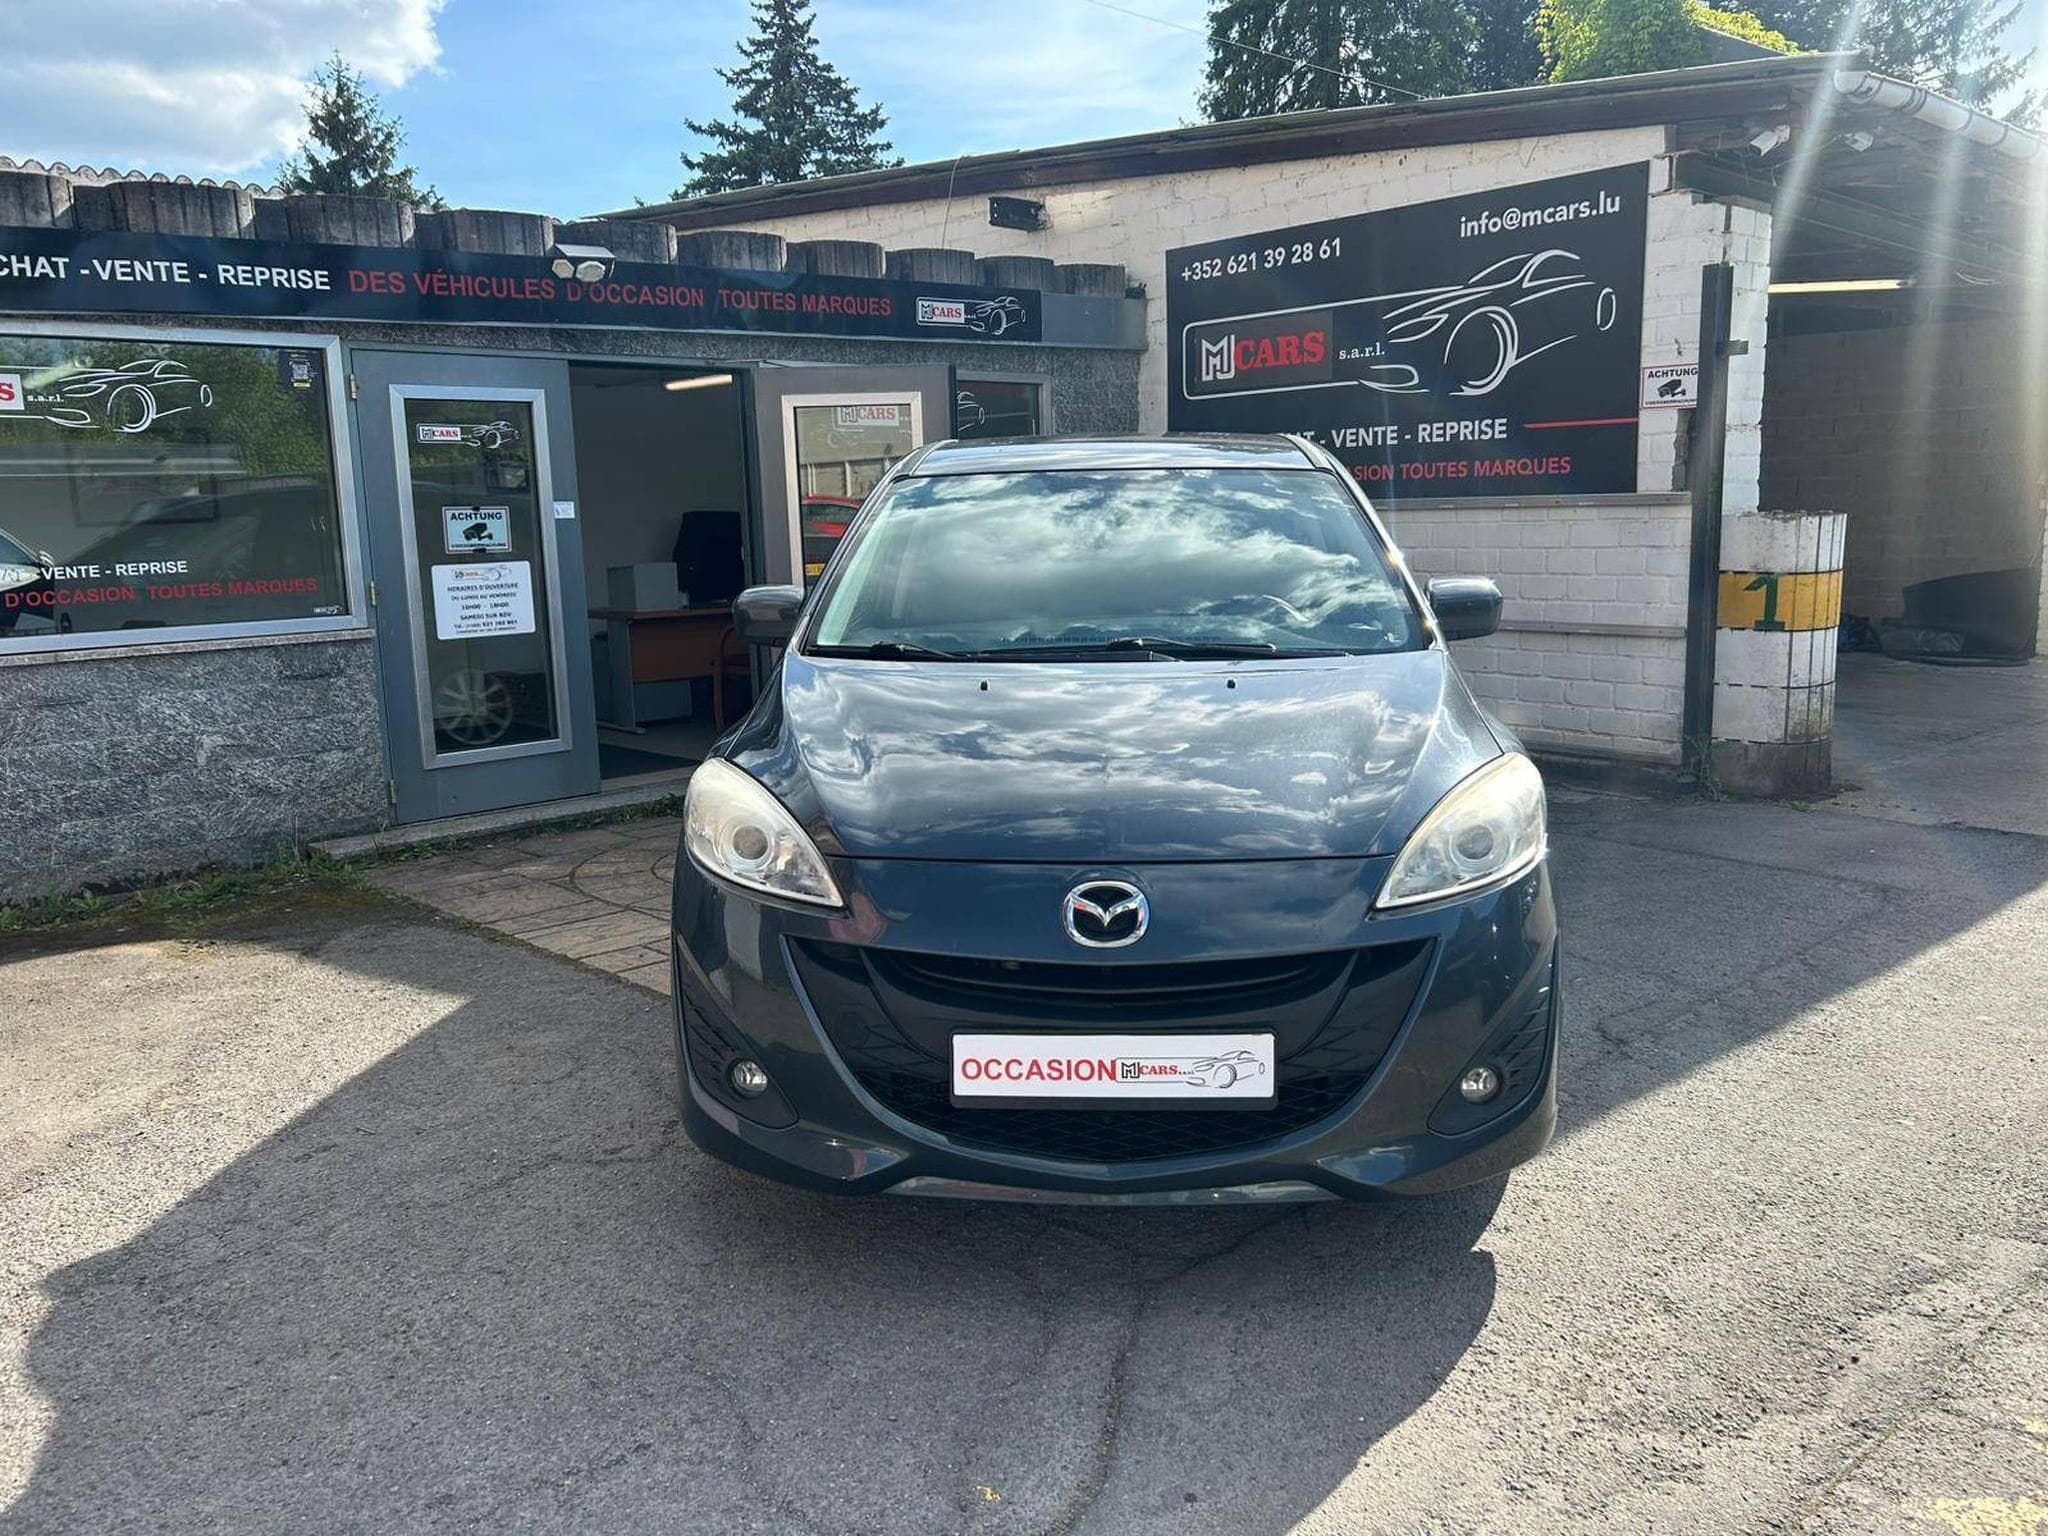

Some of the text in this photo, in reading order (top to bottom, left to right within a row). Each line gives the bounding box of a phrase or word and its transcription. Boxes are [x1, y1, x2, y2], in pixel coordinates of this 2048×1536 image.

[1460, 191, 1620, 238] info@mcars.lu
[1181, 237, 1341, 281] +352 621 39 28 61
[217, 264, 331, 290] REPRISE
[349, 269, 406, 294] DES
[412, 267, 556, 300] VÉHICULES
[566, 281, 705, 307] D'OCCASION
[719, 288, 796, 312] TOUTES
[801, 293, 892, 317] MARQUES
[1339, 342, 1386, 360] s.a.r.l.
[1648, 367, 1698, 379] ACHTUNG
[1331, 425, 1398, 448] VENTE
[1417, 418, 1508, 443] REPRISE
[1400, 460, 1468, 480] TOUTES
[1474, 456, 1572, 478] MARQUES
[450, 512, 503, 521] ACHTUNG
[115, 560, 188, 577] REPRISE
[5, 577, 320, 609] D'OCCASION TOUTES MARQUES
[1743, 573, 1785, 632] 1
[961, 1058, 1117, 1081] OCCASION
